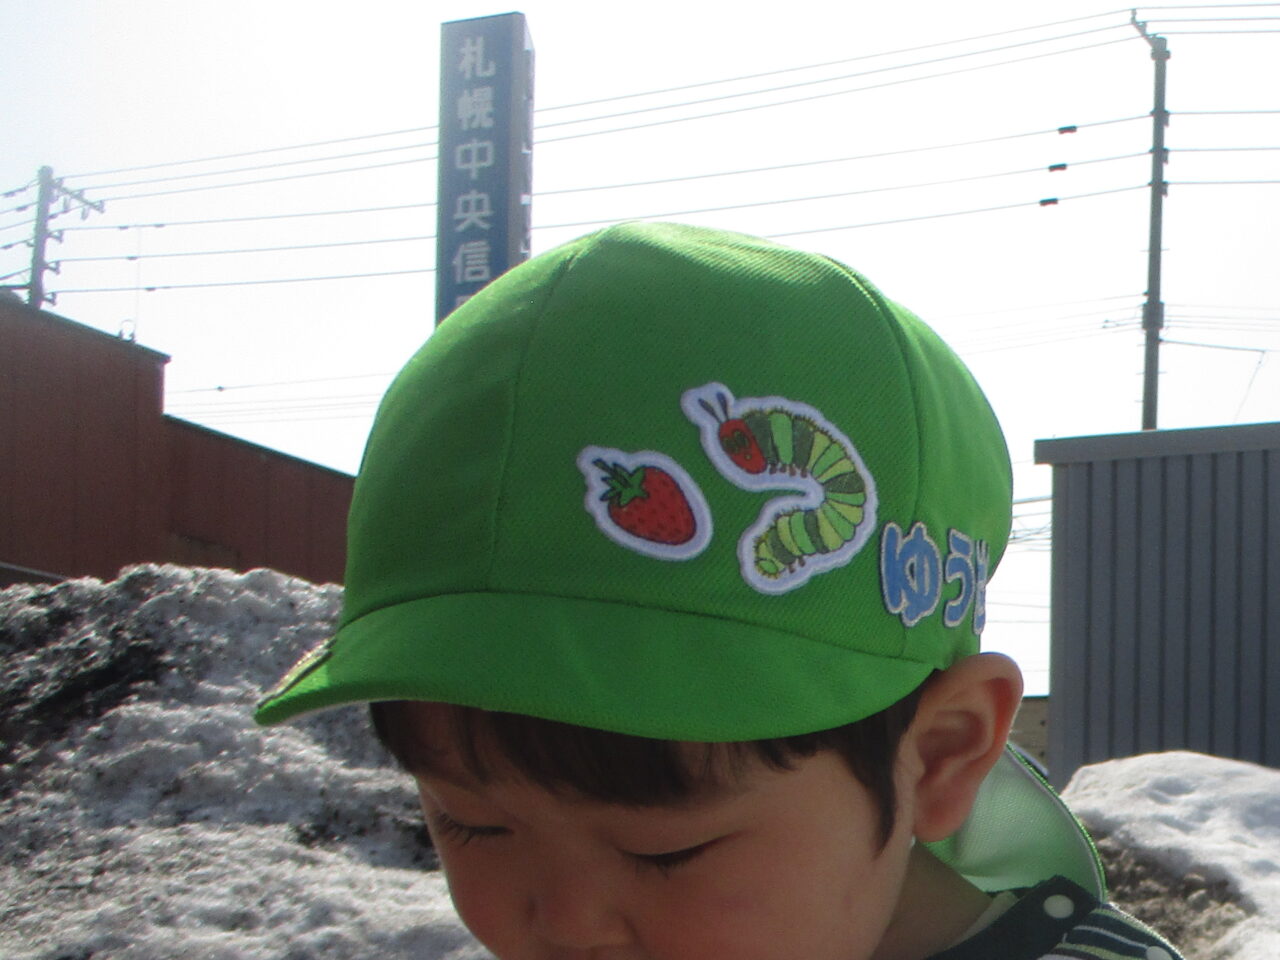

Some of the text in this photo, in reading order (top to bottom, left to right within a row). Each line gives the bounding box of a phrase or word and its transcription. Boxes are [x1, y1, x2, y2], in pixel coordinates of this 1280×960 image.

[453, 35, 497, 312] 札幌中央信
